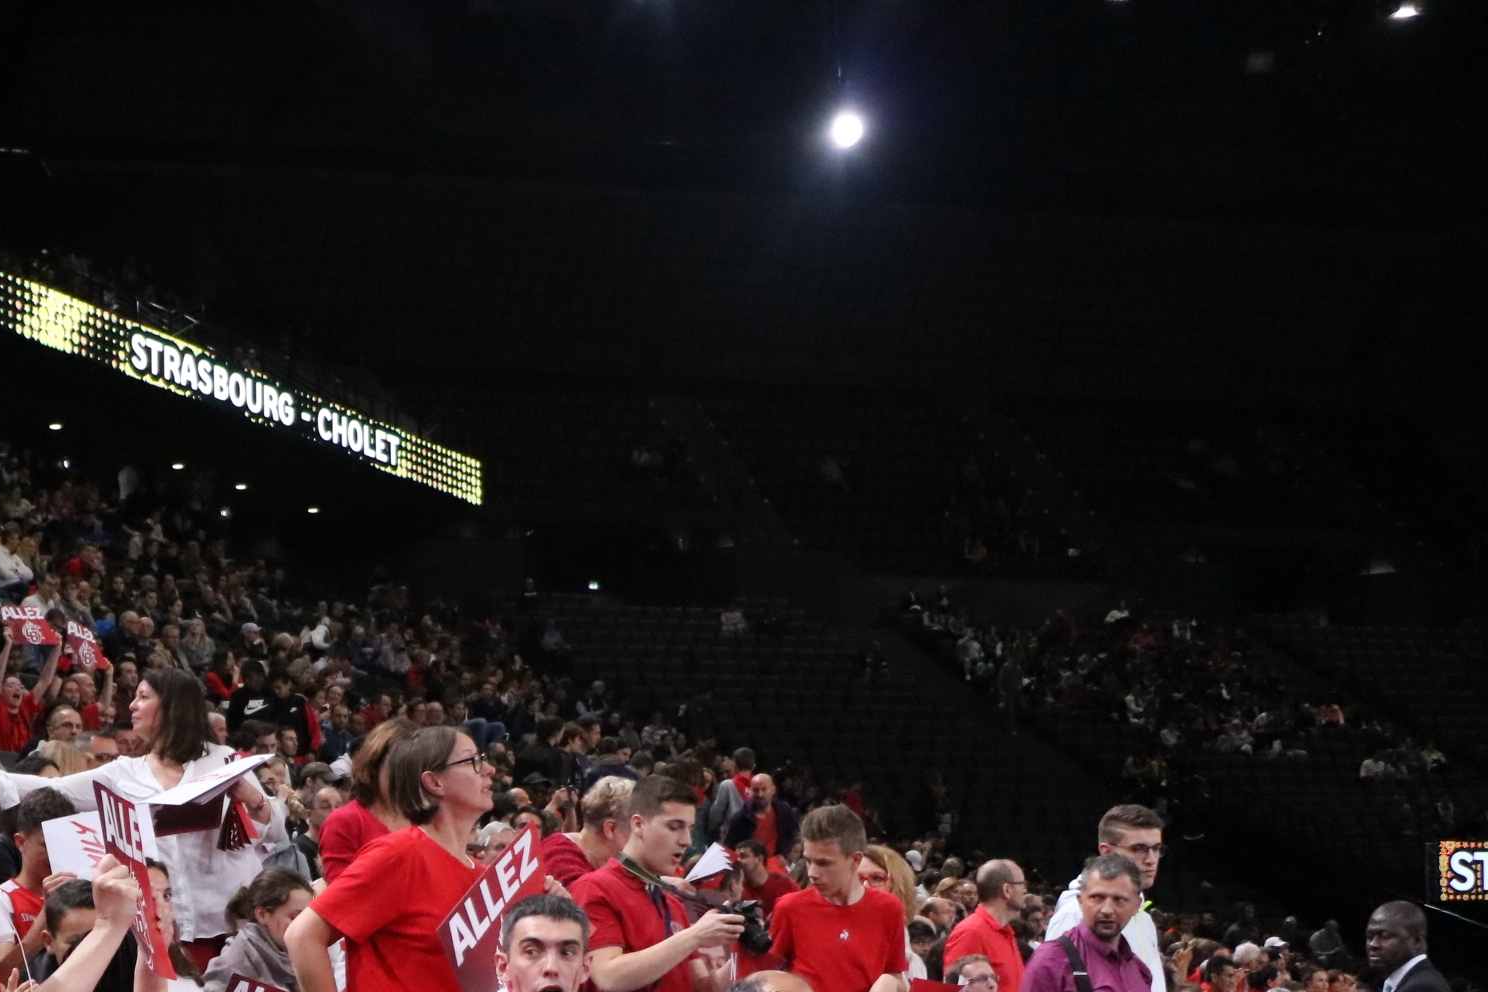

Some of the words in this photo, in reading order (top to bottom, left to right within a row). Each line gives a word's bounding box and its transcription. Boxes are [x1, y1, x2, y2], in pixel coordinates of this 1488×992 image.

[131, 334, 295, 427] STRASBOURG
[317, 408, 402, 466] CHOLET
[1, 607, 45, 620] ALLEZ
[101, 789, 147, 867] ALLE
[449, 828, 539, 967] ALLEZ
